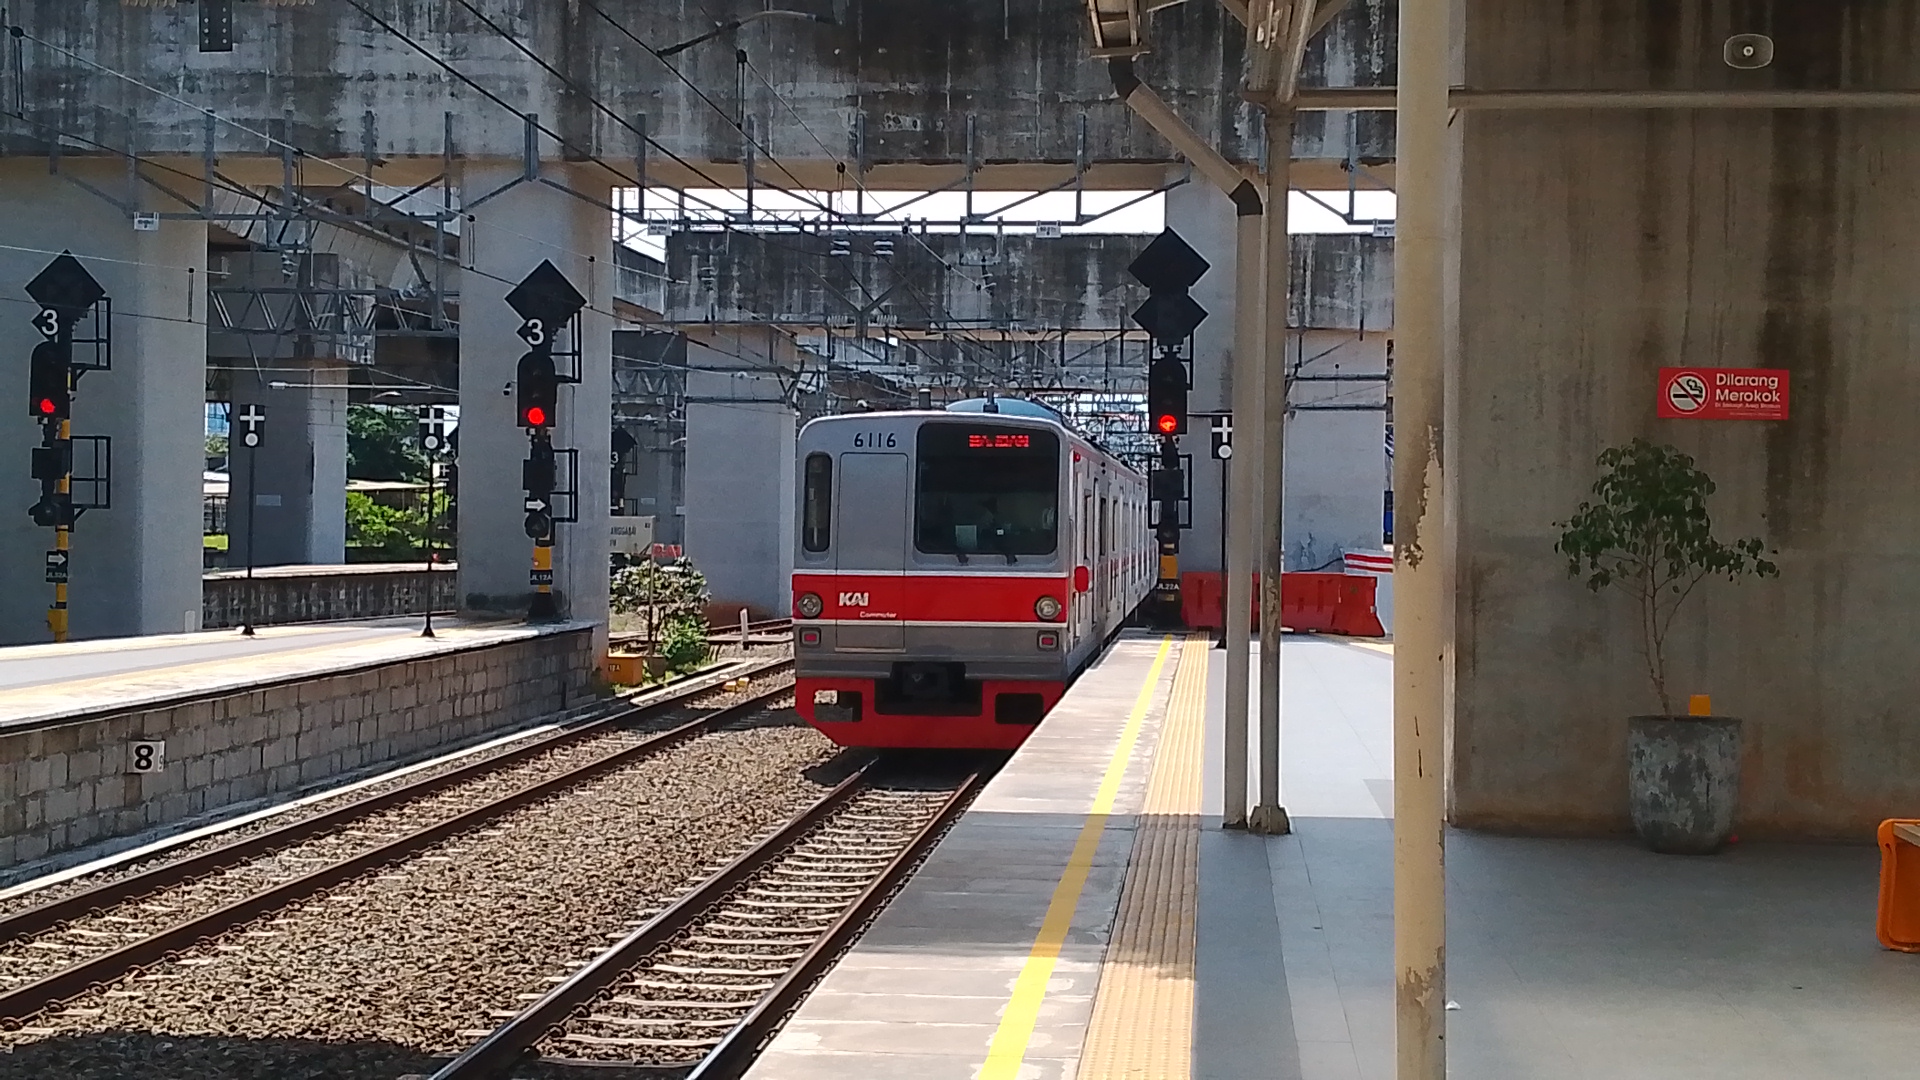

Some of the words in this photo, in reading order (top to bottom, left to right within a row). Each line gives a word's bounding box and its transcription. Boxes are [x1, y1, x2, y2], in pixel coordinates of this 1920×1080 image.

[42, 309, 59, 336] 3
[526, 318, 545, 345] 3
[1715, 373, 1779, 390] Dilarang
[1715, 389, 1781, 403] Merokok
[854, 432, 896, 448] 6116
[611, 451, 619, 464] 3
[1156, 582, 1180, 591] JL22A
[838, 592, 869, 606] KAI
[134, 744, 154, 770] 8
